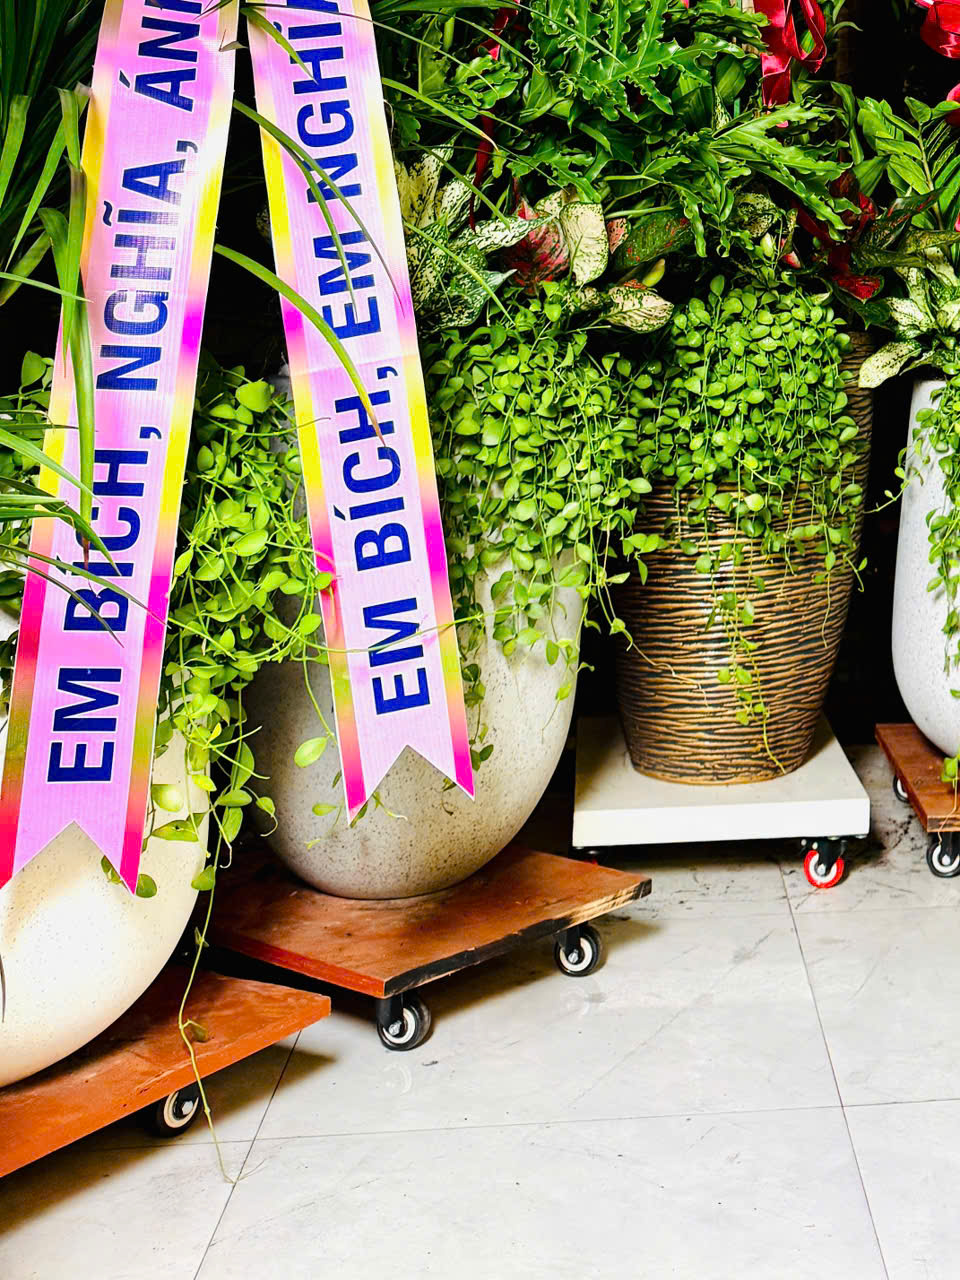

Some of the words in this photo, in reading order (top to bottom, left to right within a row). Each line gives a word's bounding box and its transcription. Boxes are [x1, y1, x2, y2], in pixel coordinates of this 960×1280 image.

[95, 139, 199, 393] NGHĨA,
[312, 229, 382, 342] EM
[56, 425, 163, 633] BÍCH,
[333, 366, 411, 572] BÍCH,
[47, 667, 123, 784] EM
[363, 596, 432, 716] EM
